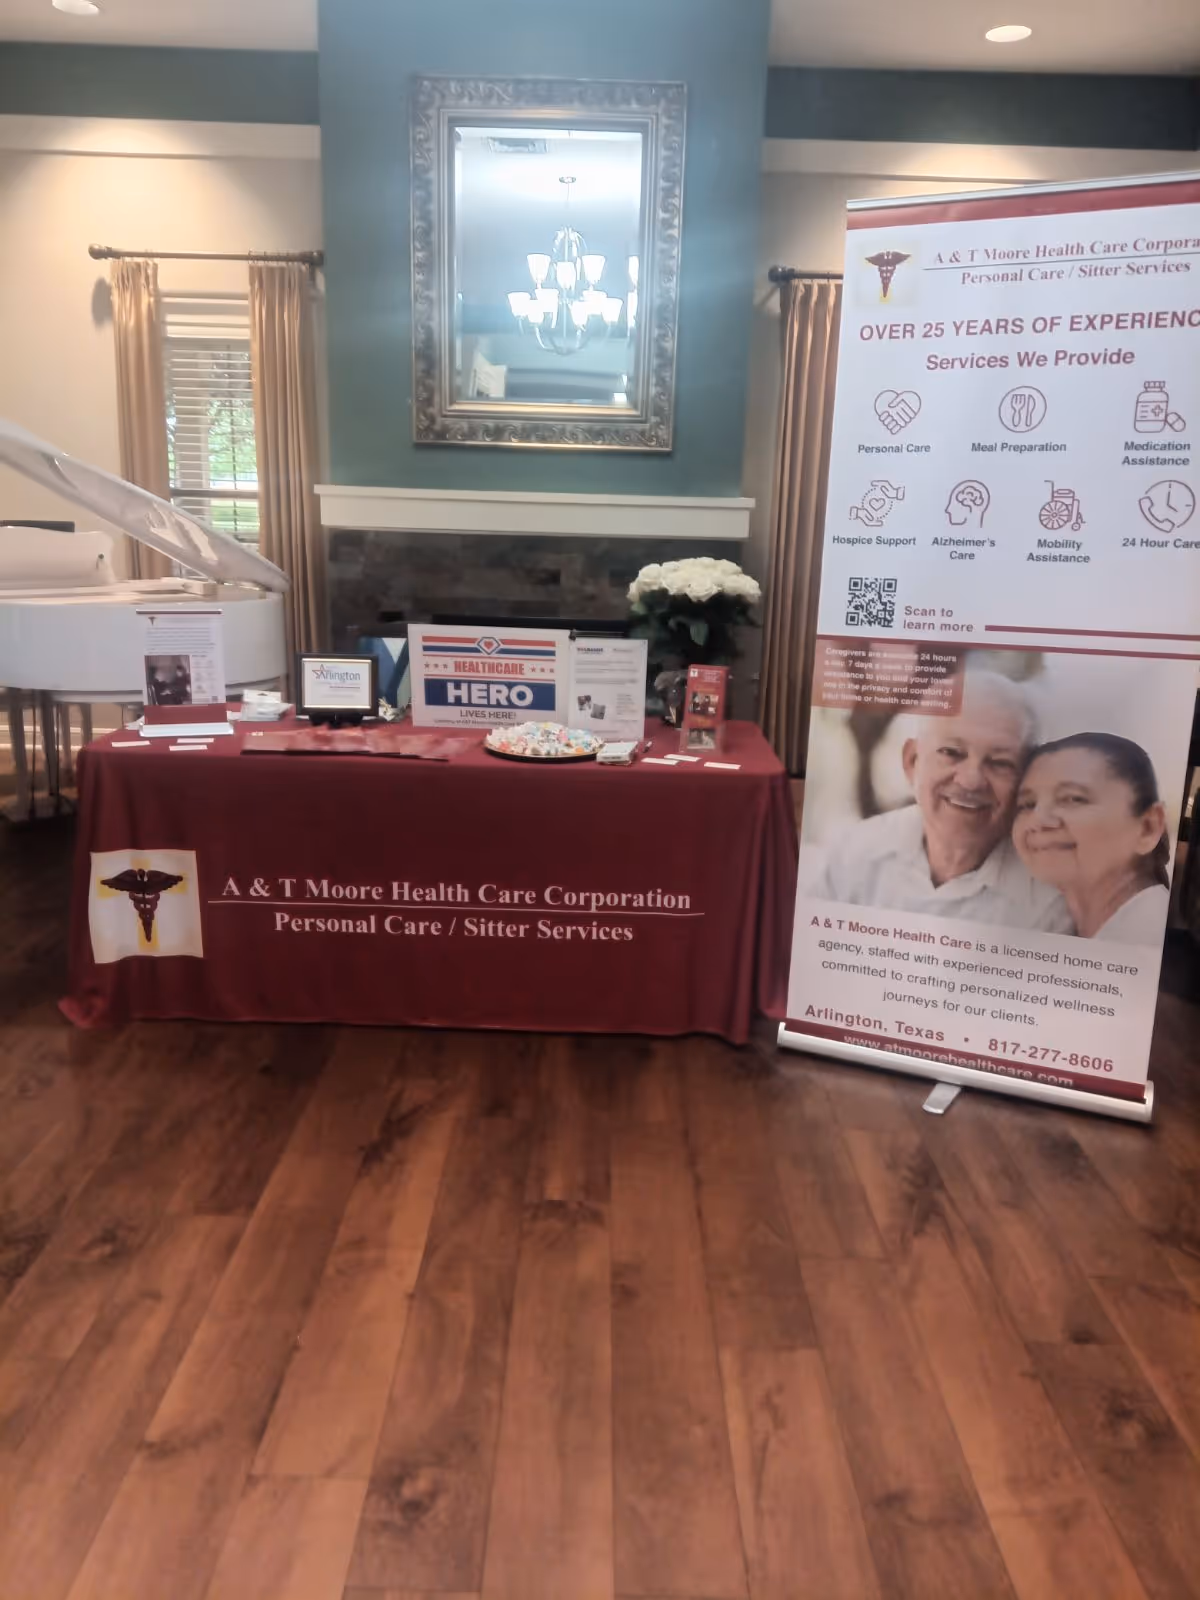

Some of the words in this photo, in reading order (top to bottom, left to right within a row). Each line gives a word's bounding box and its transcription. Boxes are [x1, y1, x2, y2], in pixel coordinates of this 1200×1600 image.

[934, 252, 944, 264] A
[948, 250, 961, 264] &
[967, 249, 979, 262] T
[984, 246, 1030, 261] Moore
[1035, 242, 1085, 258] Health
[1090, 240, 1128, 255] Care
[961, 269, 1023, 285] Personal
[1028, 266, 1064, 282] Care
[1078, 263, 1122, 279] Sitter
[1126, 260, 1191, 276] Services
[860, 323, 916, 341] OVER
[922, 322, 944, 339] 25
[952, 318, 1024, 337] YEARS
[1032, 316, 1062, 334] OF
[926, 353, 1009, 371] Services
[1016, 351, 1048, 368] We
[1054, 348, 1135, 367] Provide
[858, 444, 903, 454] Personal
[906, 444, 931, 453] Care
[971, 442, 998, 453] Meal
[1000, 442, 1067, 454] Preparation
[1124, 441, 1190, 452] Medication
[1122, 455, 1190, 466] Assistance
[832, 536, 874, 547] Hospice
[876, 536, 916, 548] Support
[932, 537, 996, 548] Alzheimer's
[1037, 538, 1082, 551] Mobility
[1122, 538, 1136, 548] 24
[1140, 538, 1170, 548] Hour
[1173, 538, 1200, 549] Care
[950, 550, 976, 561] Care
[1026, 553, 1090, 564] Assistance
[904, 606, 936, 618] Scan
[940, 607, 954, 618] to
[903, 620, 936, 631] learn
[940, 623, 974, 633] more
[920, 653, 930, 661] 24
[932, 654, 957, 662] hours
[453, 660, 525, 676] HEALTHCARE
[914, 665, 946, 673] provide
[446, 682, 534, 707] HERO
[861, 684, 890, 694] privacy
[892, 686, 908, 694] and
[460, 709, 486, 718] LIVES
[488, 711, 516, 720] HERE!
[222, 876, 241, 896] A
[250, 877, 271, 898] &
[278, 878, 296, 898] T
[305, 878, 384, 900] Moore
[392, 881, 470, 902] Health
[478, 883, 537, 904] Care
[544, 885, 691, 912] Corporation
[274, 912, 376, 934] Personal
[384, 914, 442, 936] Care
[448, 917, 457, 936] /
[464, 917, 530, 938] Sitter
[536, 919, 634, 941] Services
[810, 916, 820, 927] A
[824, 918, 832, 929] &
[836, 919, 846, 930] T
[848, 921, 890, 937] Moore
[893, 928, 936, 944] Health
[940, 934, 972, 950] Care
[976, 940, 986, 952] is
[990, 944, 999, 954] a
[1003, 944, 1059, 964] licensed
[1064, 954, 1102, 970] home
[1106, 962, 1138, 976] care
[818, 939, 864, 956] agency,
[868, 946, 910, 962] staffed
[914, 954, 939, 967] with
[943, 958, 1024, 980] experienced
[1027, 972, 1123, 998] professionals,
[821, 960, 887, 978] committed
[890, 969, 903, 982] to
[906, 973, 956, 993] crafting
[960, 982, 1048, 1006] personalized
[1053, 998, 1115, 1017] wellness
[882, 988, 938, 1009] journeys
[943, 998, 961, 1012] for
[964, 1005, 987, 1017] our
[990, 1008, 1039, 1027] clients.
[804, 1004, 888, 1032] Arlington,
[894, 1020, 945, 1042] Texas
[988, 1038, 1114, 1072] 817-277-8606
